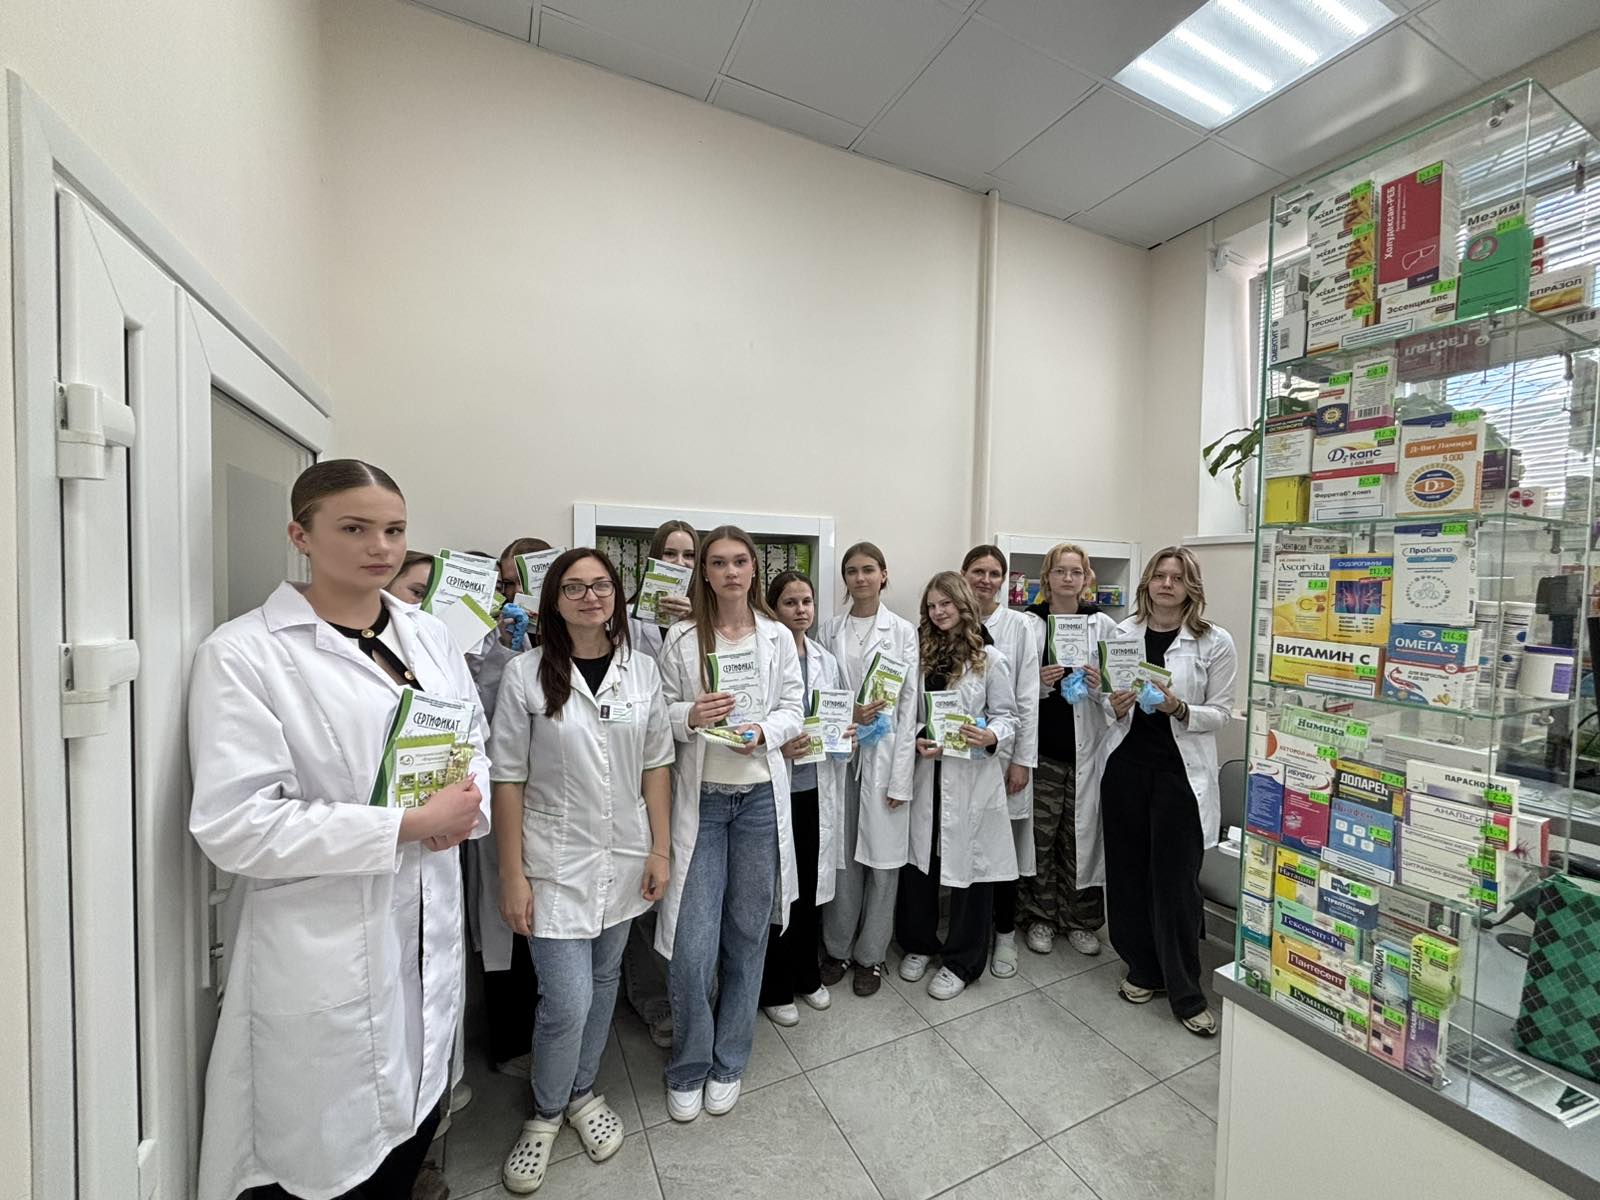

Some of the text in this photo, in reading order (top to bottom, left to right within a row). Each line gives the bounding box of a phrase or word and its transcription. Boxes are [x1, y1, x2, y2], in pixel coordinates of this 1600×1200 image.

[1467, 202, 1520, 227] Мезим
[1386, 294, 1448, 314] Эссенцикапс
[1409, 547, 1453, 555] Пробакто
[1279, 562, 1326, 571] Ascorvita
[446, 576, 486, 592] СЕРТИФИКАТ
[1110, 648, 1139, 656] СЕРТИФИКАТ
[1276, 644, 1370, 666] ВИТАМИН С
[722, 662, 754, 673] СЕРТИФИКАТ
[822, 700, 848, 708] СЕРТИФИКАТ
[413, 712, 461, 731] СЕРТИФИКАТ
[1298, 718, 1344, 736] Нимика
[1288, 768, 1316, 780] ИБУФЕН
[1444, 774, 1508, 792] ПАРАСКОФЕН
[1434, 807, 1491, 824] АНАЛЬГИН
[1290, 954, 1344, 985] Пантесепт
[1412, 944, 1424, 982] РУЗАНА
